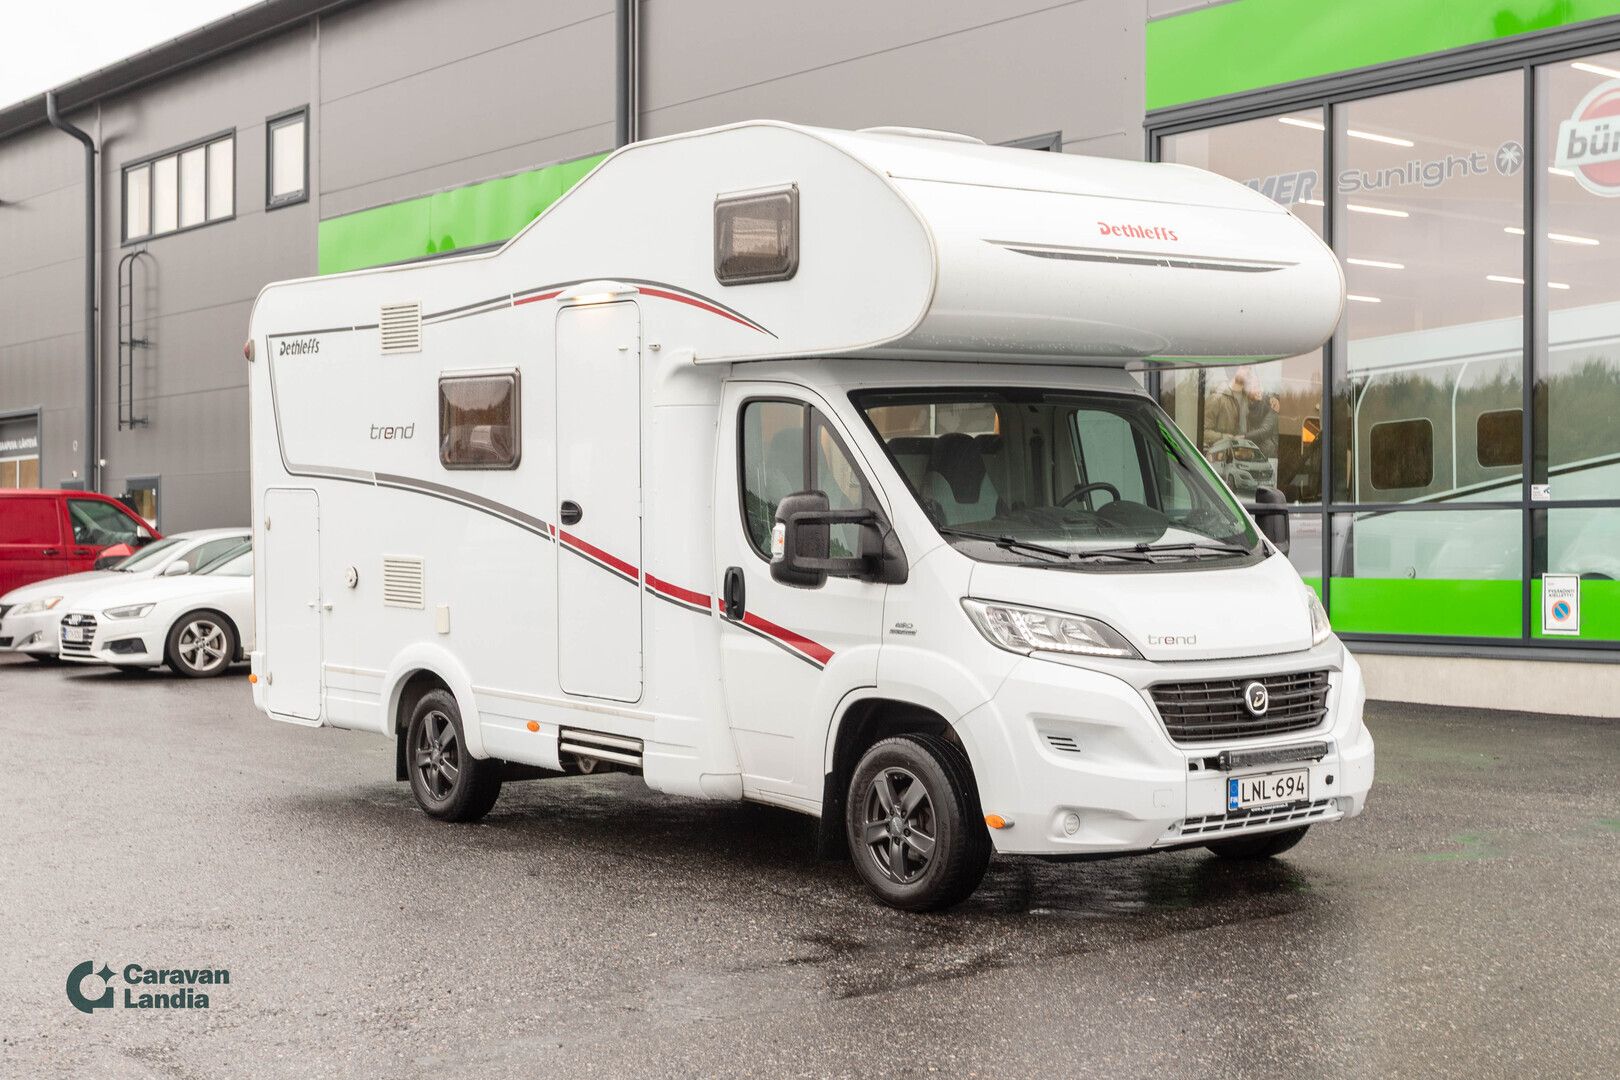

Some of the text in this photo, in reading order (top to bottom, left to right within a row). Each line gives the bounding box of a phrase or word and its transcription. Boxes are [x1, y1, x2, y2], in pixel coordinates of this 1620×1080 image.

[1338, 151, 1489, 194] Sunlight
[1242, 169, 1318, 205] MER
[1097, 221, 1178, 241] Dethleffs
[279, 338, 320, 356] Dethleffs
[370, 422, 415, 440] trend
[1148, 634, 1197, 645] trend
